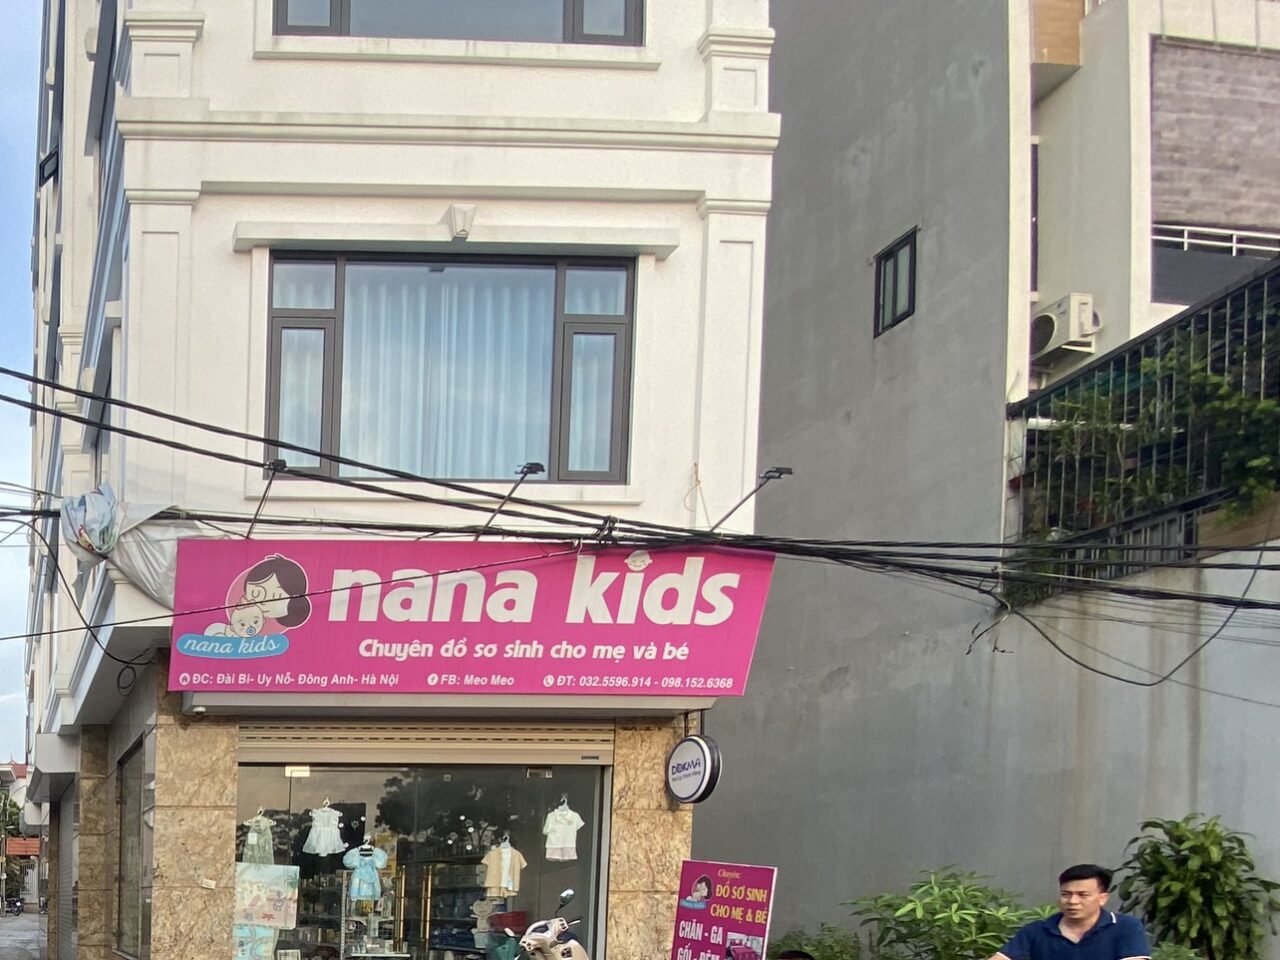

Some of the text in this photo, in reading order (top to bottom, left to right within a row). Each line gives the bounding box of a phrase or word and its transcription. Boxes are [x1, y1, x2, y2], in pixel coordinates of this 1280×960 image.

[328, 550, 741, 626] nana kids
[184, 635, 280, 654] nana kids
[359, 639, 433, 661] Chuyên
[473, 643, 498, 658] sơ
[503, 639, 543, 659] sinh
[550, 641, 586, 659] cho
[592, 645, 625, 663] mẹ
[633, 642, 657, 660] và
[662, 642, 689, 660] bé
[192, 673, 213, 684] ĐC:
[217, 673, 235, 684] Đài
[257, 673, 272, 687] Uy
[298, 673, 328, 687] Đông
[361, 673, 376, 685] Hà
[380, 674, 399, 687] Nội
[440, 675, 460, 685] FB:
[464, 675, 488, 685] Meo
[490, 675, 514, 685] Meo
[557, 676, 576, 686] ĐT:
[579, 676, 651, 687] 032.5596.914
[661, 677, 733, 688] 098.152.6368
[746, 888, 768, 902] SINH
[710, 903, 730, 918] CHO
[731, 906, 744, 924] MẸ
[746, 908, 753, 922] &
[755, 907, 768, 924] BÉ
[678, 918, 724, 945] CHĂN GA
